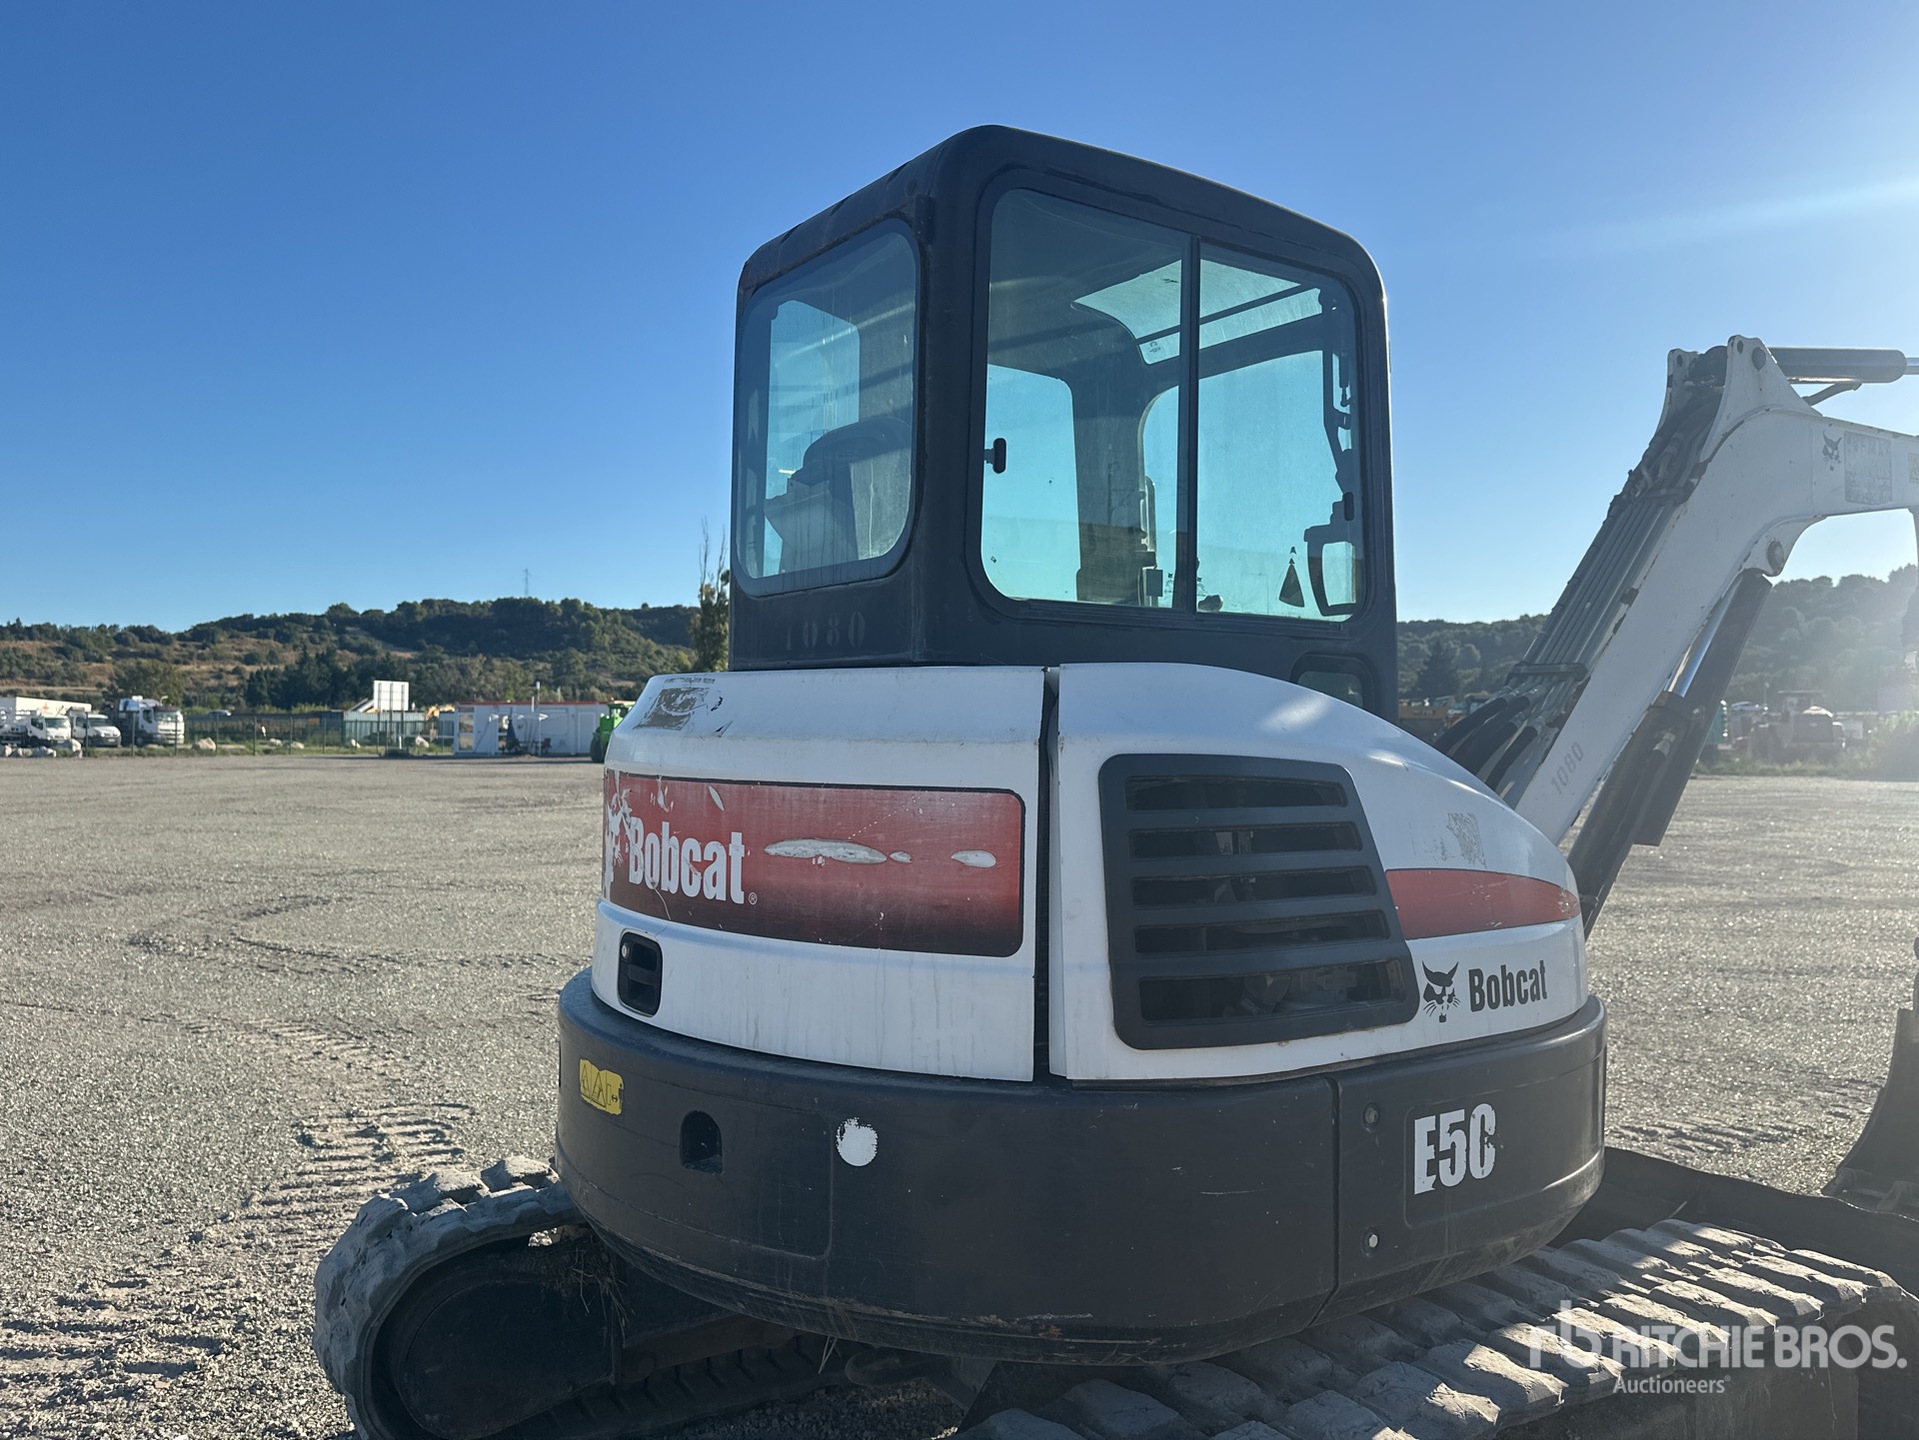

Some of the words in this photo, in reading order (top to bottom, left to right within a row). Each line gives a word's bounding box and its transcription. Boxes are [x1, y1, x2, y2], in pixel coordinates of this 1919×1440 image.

[786, 614, 865, 651] 1080
[1552, 742, 1584, 795] 1080
[629, 822, 745, 905] Bobcat
[1468, 960, 1548, 1012] Bobcat
